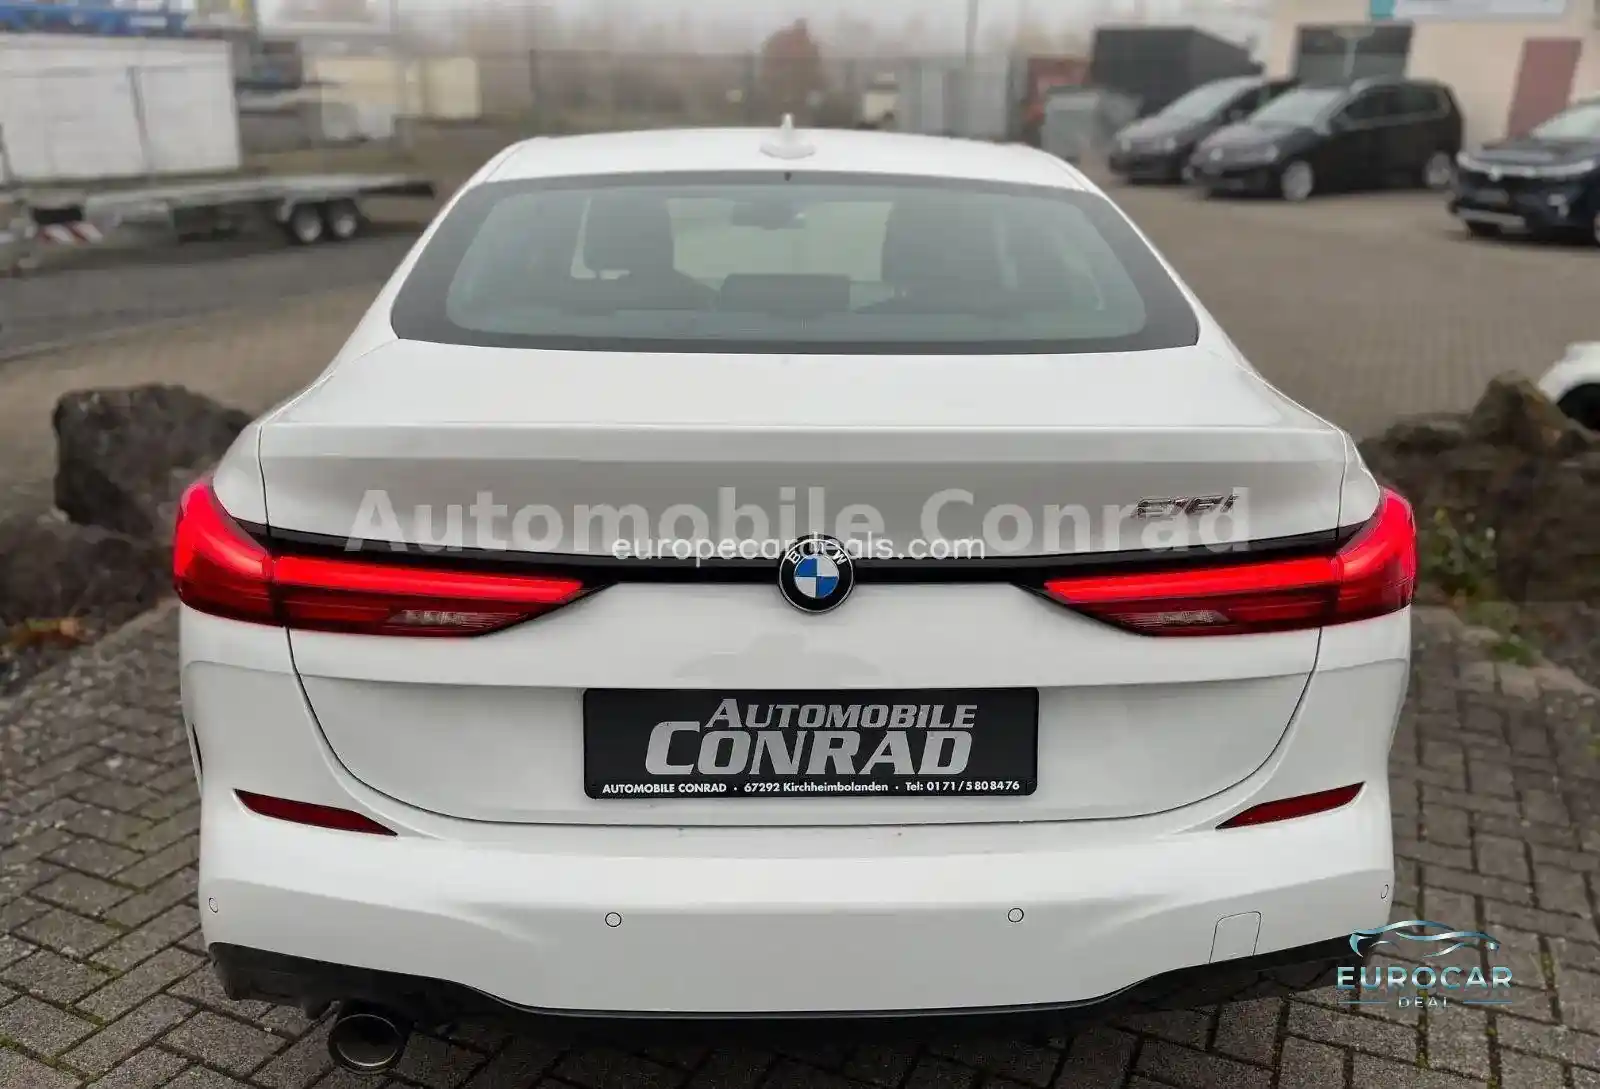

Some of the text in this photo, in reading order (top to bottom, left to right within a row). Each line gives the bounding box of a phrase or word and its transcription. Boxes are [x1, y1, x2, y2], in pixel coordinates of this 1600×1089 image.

[704, 698, 978, 728] AUTOMOBILE
[645, 720, 973, 775] CONRAD
[602, 783, 675, 794] AUTOMOBILE
[678, 782, 727, 793] CONRAD
[744, 782, 780, 793] 67292
[783, 781, 889, 793] Kirchheimbolanden
[905, 781, 924, 792] Tel:
